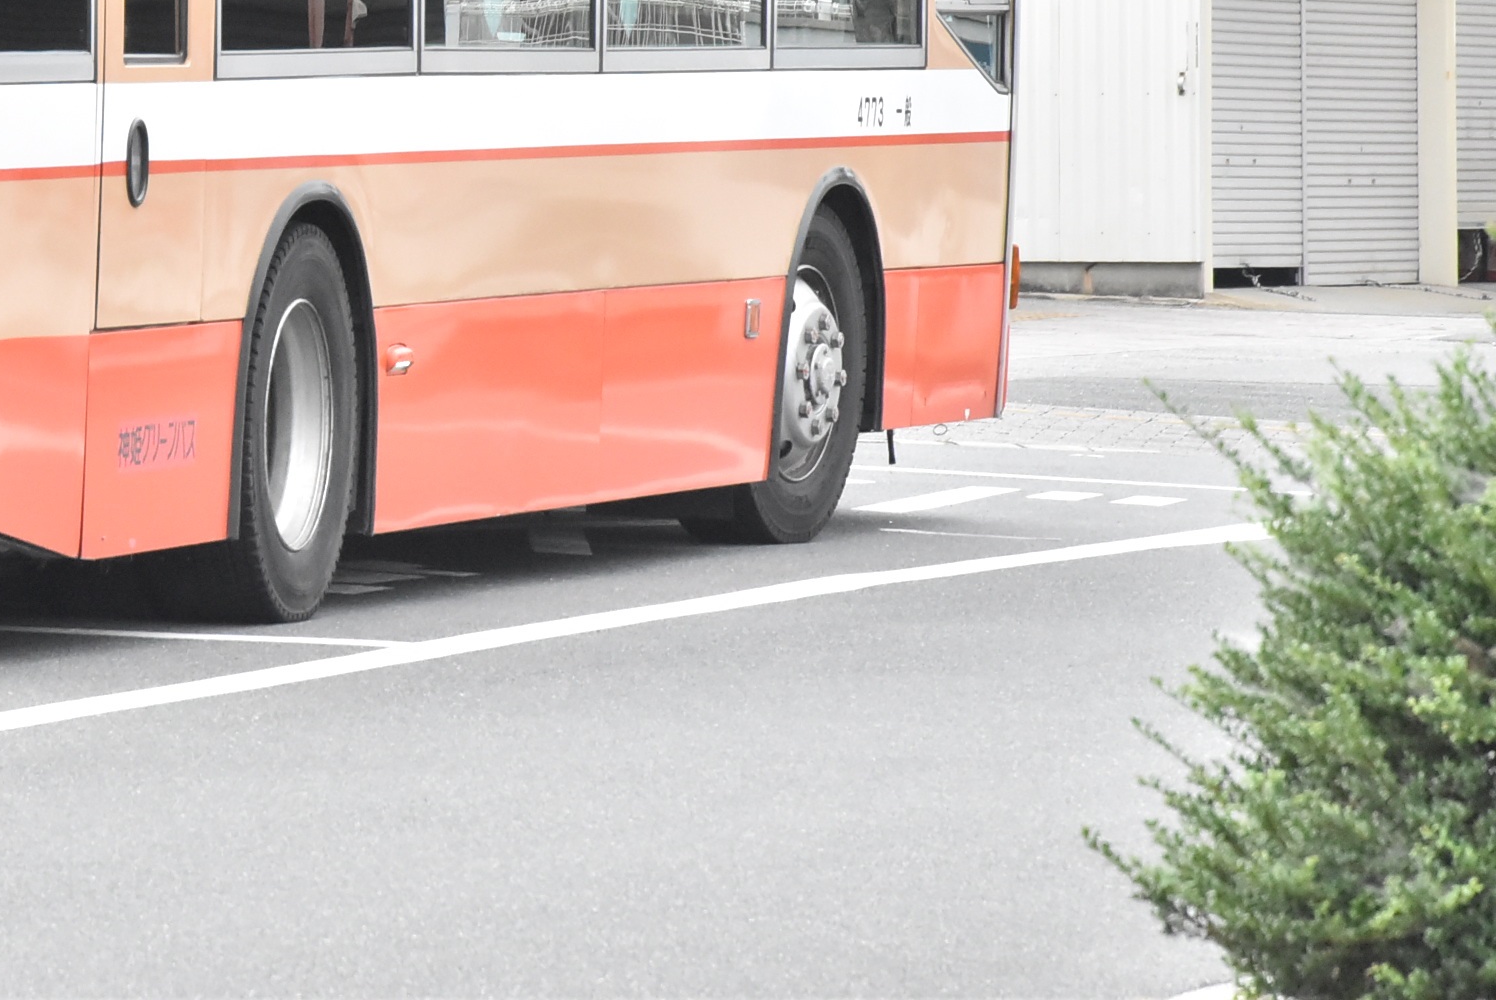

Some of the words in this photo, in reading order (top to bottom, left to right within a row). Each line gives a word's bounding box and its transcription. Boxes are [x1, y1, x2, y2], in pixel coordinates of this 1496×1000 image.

[857, 96, 885, 128] 4773
[117, 420, 196, 468] 神姫グリーンバス
